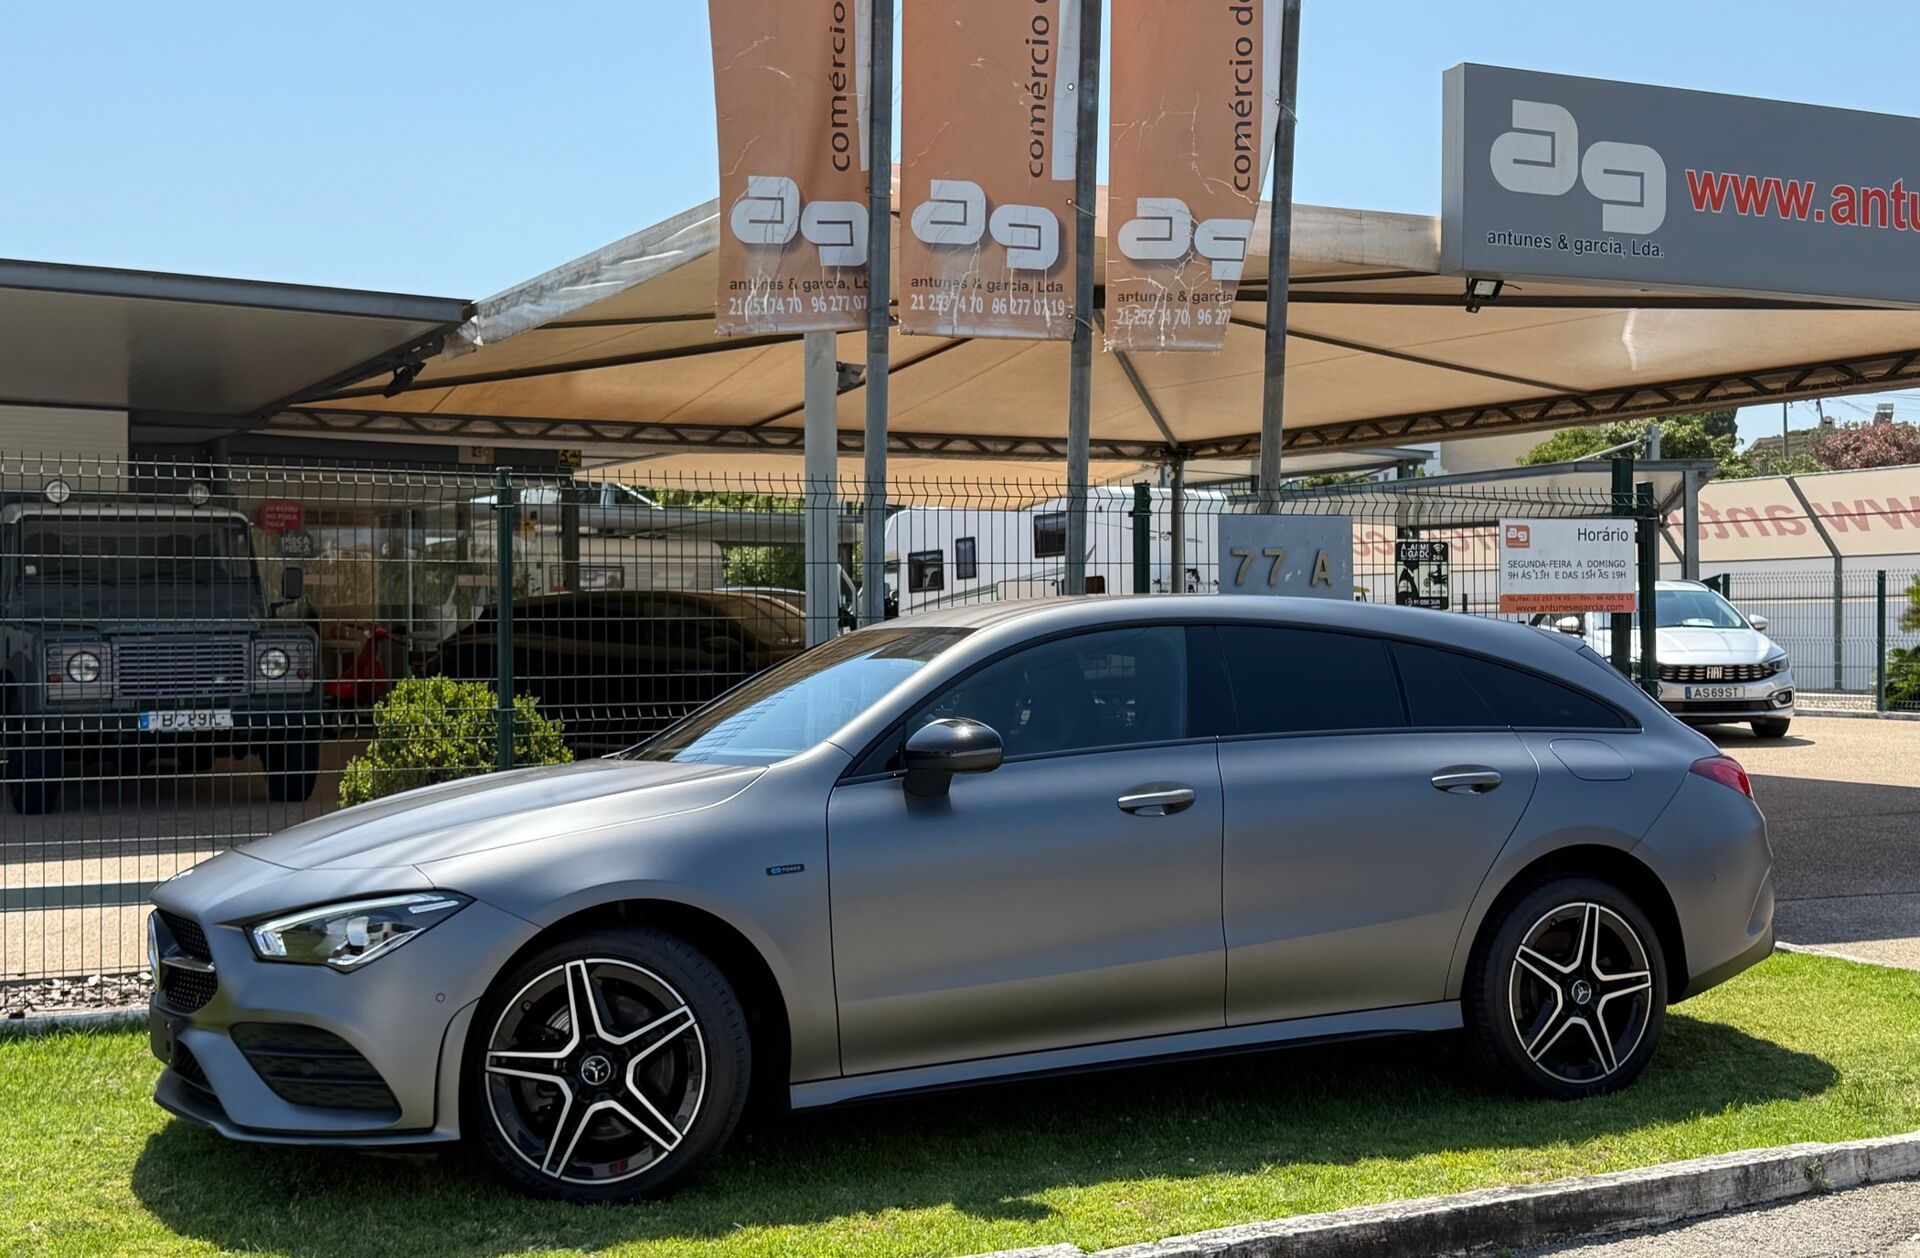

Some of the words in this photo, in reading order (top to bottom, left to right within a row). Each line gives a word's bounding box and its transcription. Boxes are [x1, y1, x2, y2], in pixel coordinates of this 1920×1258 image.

[828, 1, 850, 172] comércio
[1025, 15, 1050, 178] comércio
[1228, 37, 1253, 192] comércio
[1487, 229, 1552, 249] antunes
[1557, 234, 1569, 250] &
[1574, 238, 1627, 258] garcia,
[1632, 240, 1664, 257] Lda.
[987, 281, 1033, 294] garcia,
[1178, 291, 1188, 302] &
[729, 297, 743, 315] 21
[770, 298, 784, 315] 74
[786, 297, 803, 313] 70
[811, 296, 828, 313] 96
[829, 295, 850, 312] 277
[911, 294, 925, 310] 21
[970, 296, 984, 313] 70
[1010, 299, 1030, 315] 277
[1051, 300, 1065, 316] 19
[1174, 309, 1188, 325] 70
[1197, 309, 1212, 325] 96
[1577, 526, 1629, 542] Horário
[1311, 548, 1334, 587] A
[1508, 560, 1572, 569] SEGUNDA-FEIRA
[1577, 560, 1583, 568] A
[1587, 560, 1626, 568] DOMINGO
[1508, 571, 1519, 579] 9H
[1555, 571, 1560, 579] E
[1562, 571, 1578, 579] DAS
[1582, 571, 1596, 579] 15H
[1612, 571, 1626, 579] 19H
[1707, 666, 1723, 679] FIAT
[1694, 687, 1739, 698] AS69ST
